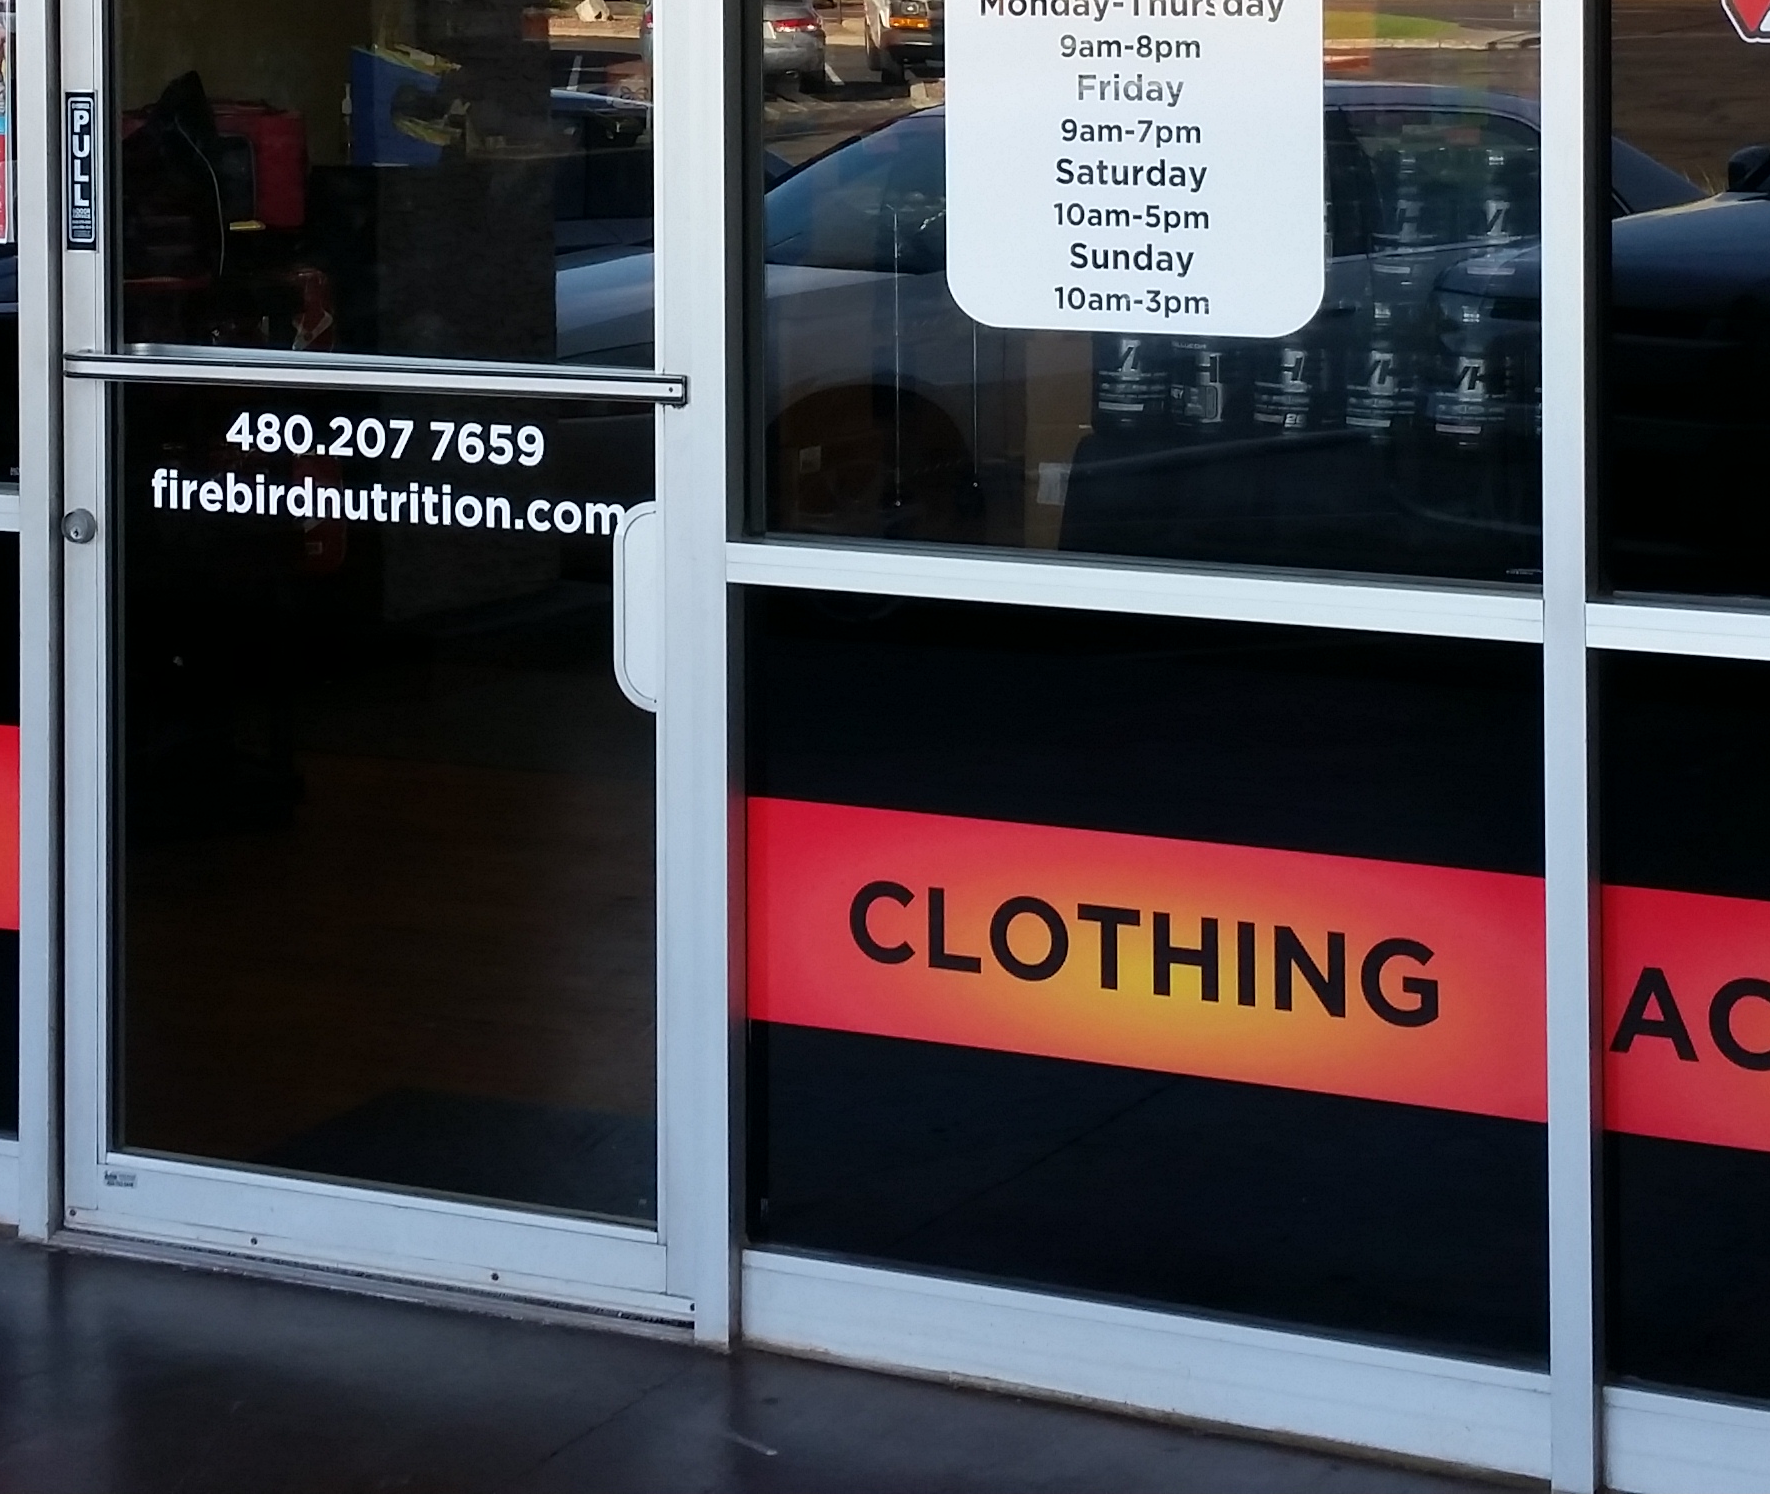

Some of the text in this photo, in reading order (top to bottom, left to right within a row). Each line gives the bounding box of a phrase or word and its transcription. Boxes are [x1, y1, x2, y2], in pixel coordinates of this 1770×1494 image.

[1059, 34, 1201, 63] 9am-8pm
[1077, 73, 1185, 107] Friday
[1060, 118, 1202, 149] 9am-7pm
[72, 110, 90, 206] PULL
[1055, 158, 1208, 194] Saturday
[1052, 203, 1210, 234] 10am-5pm
[1069, 242, 1194, 277] Sunday
[1053, 286, 1210, 318] 10am-3pm
[225, 412, 545, 466] 480.207 7659
[151, 468, 626, 536] firebirdnutrition.com
[849, 879, 1439, 1028] CLOTHING
